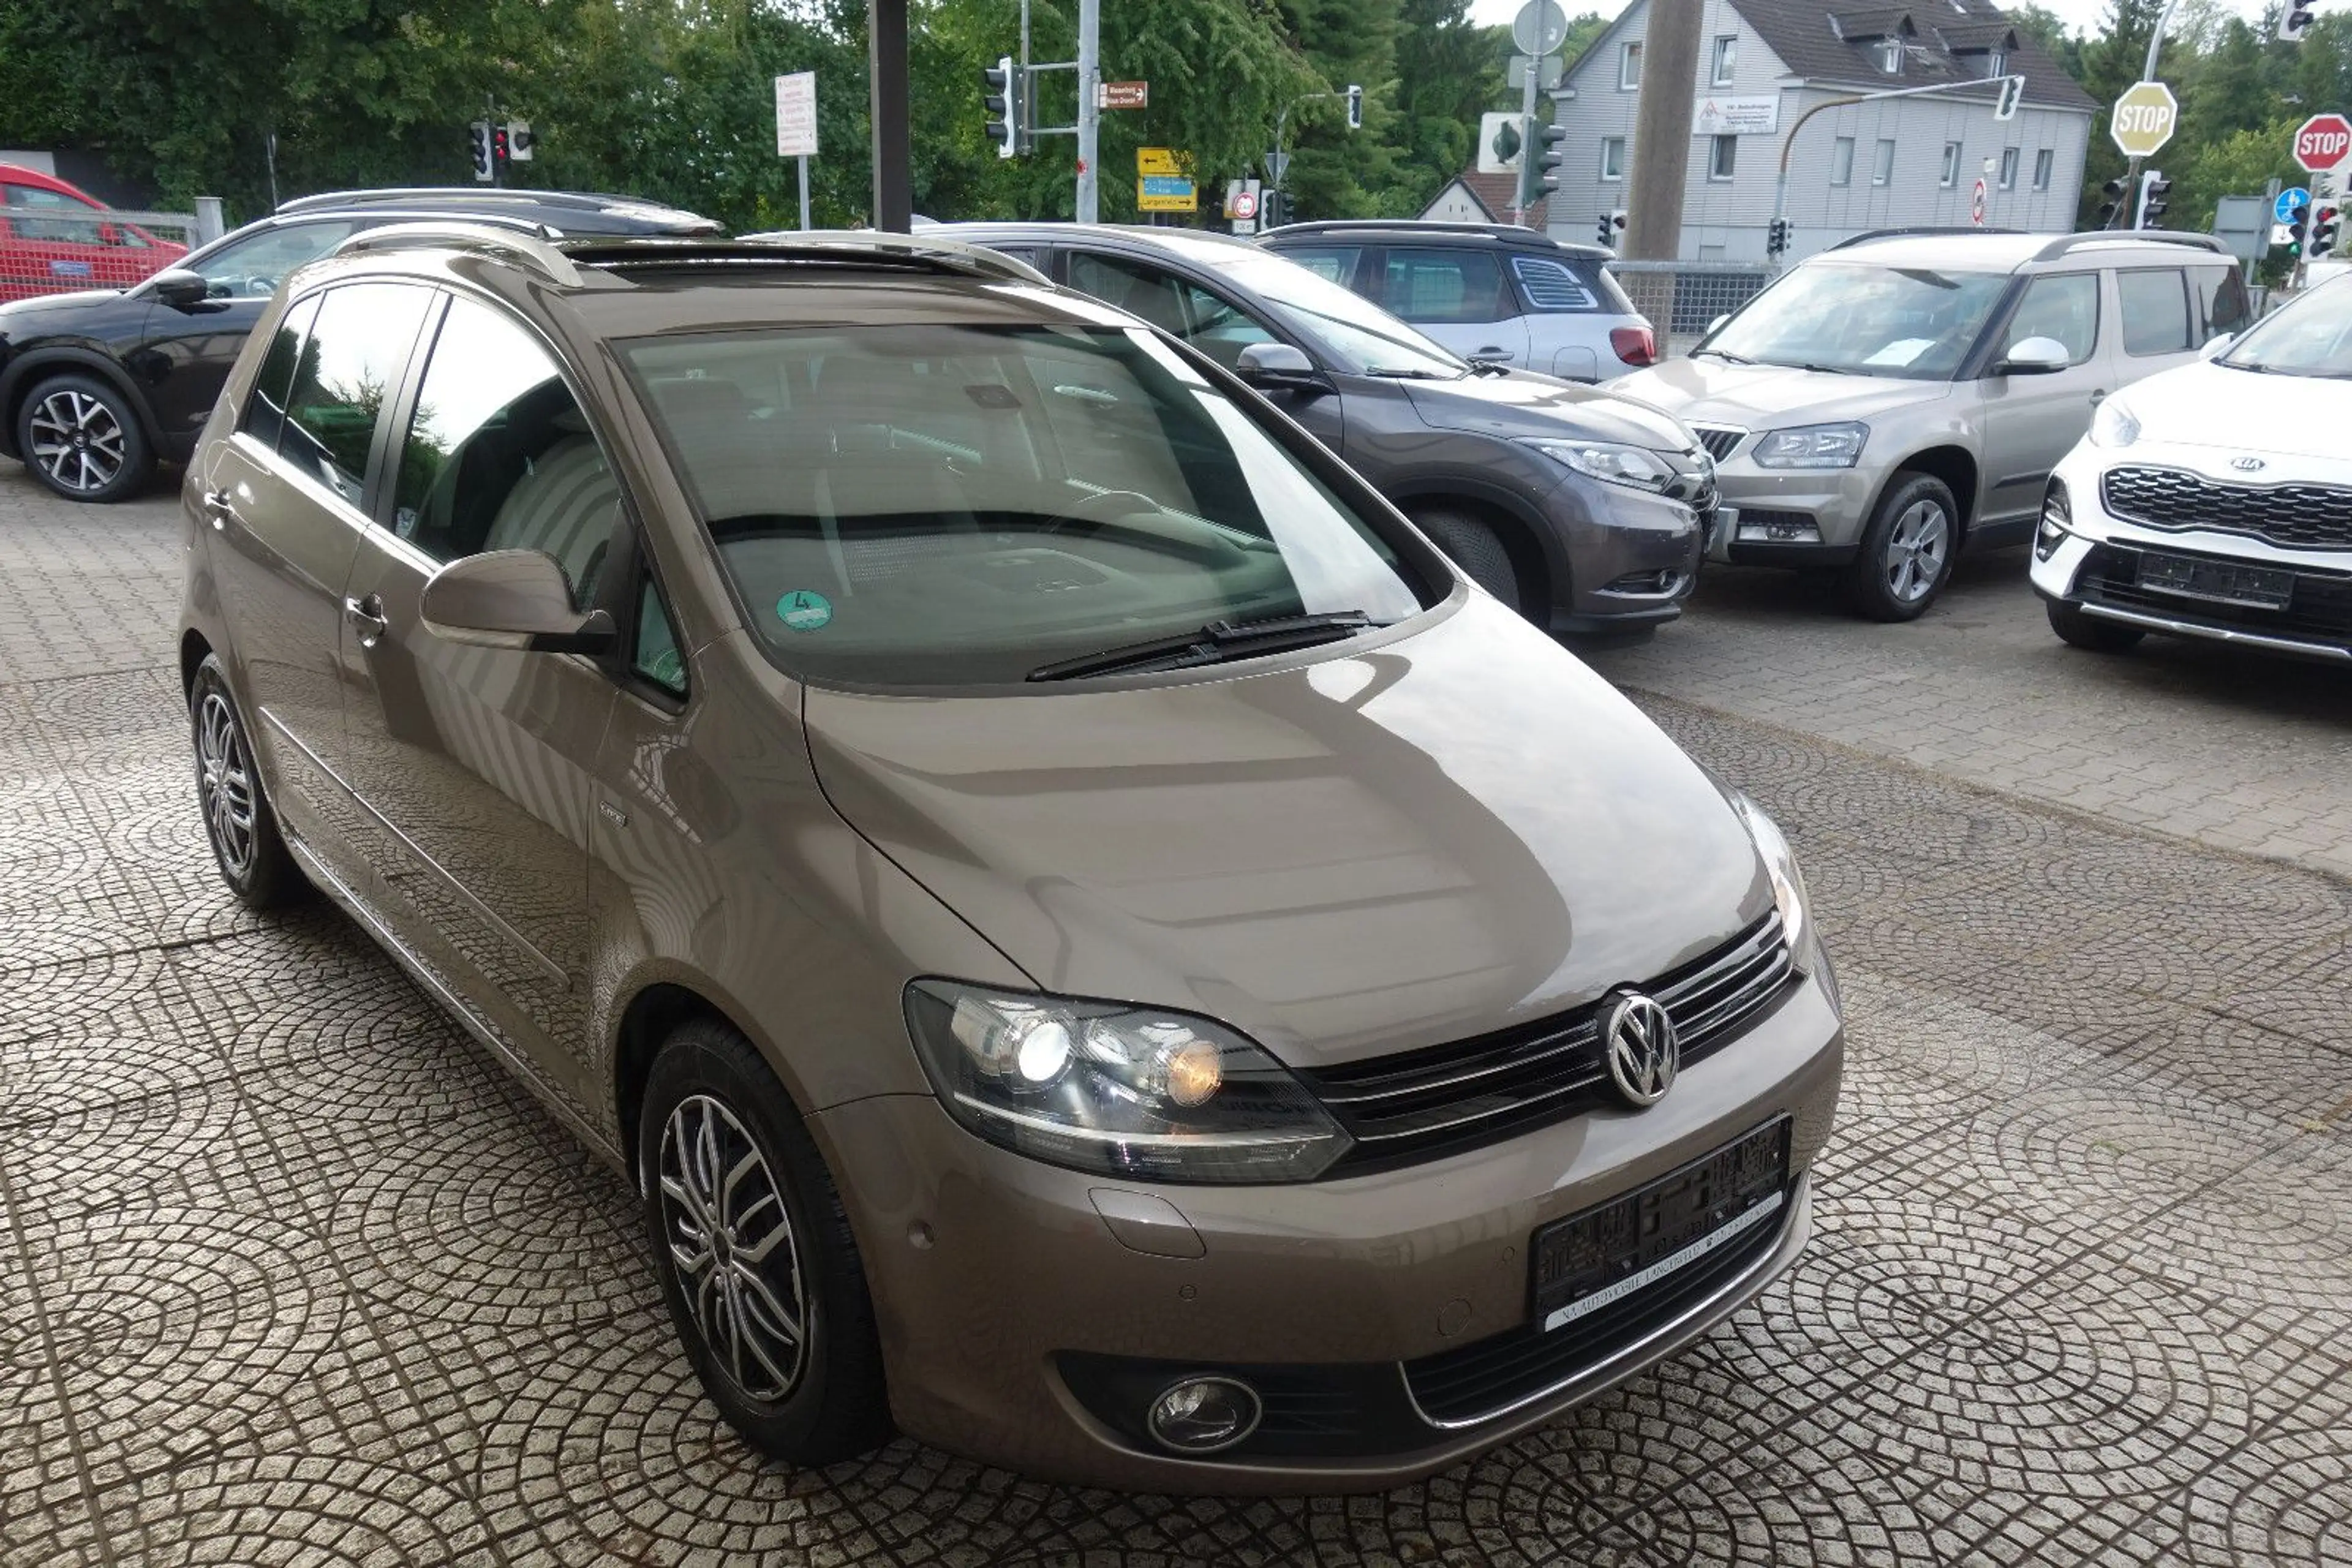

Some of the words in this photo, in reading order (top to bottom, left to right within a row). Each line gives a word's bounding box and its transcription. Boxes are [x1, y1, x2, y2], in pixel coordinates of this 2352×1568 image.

[2119, 105, 2169, 133] STOP
[2299, 132, 2348, 156] STOP
[2233, 458, 2261, 470] KIA
[795, 592, 810, 609] 4
